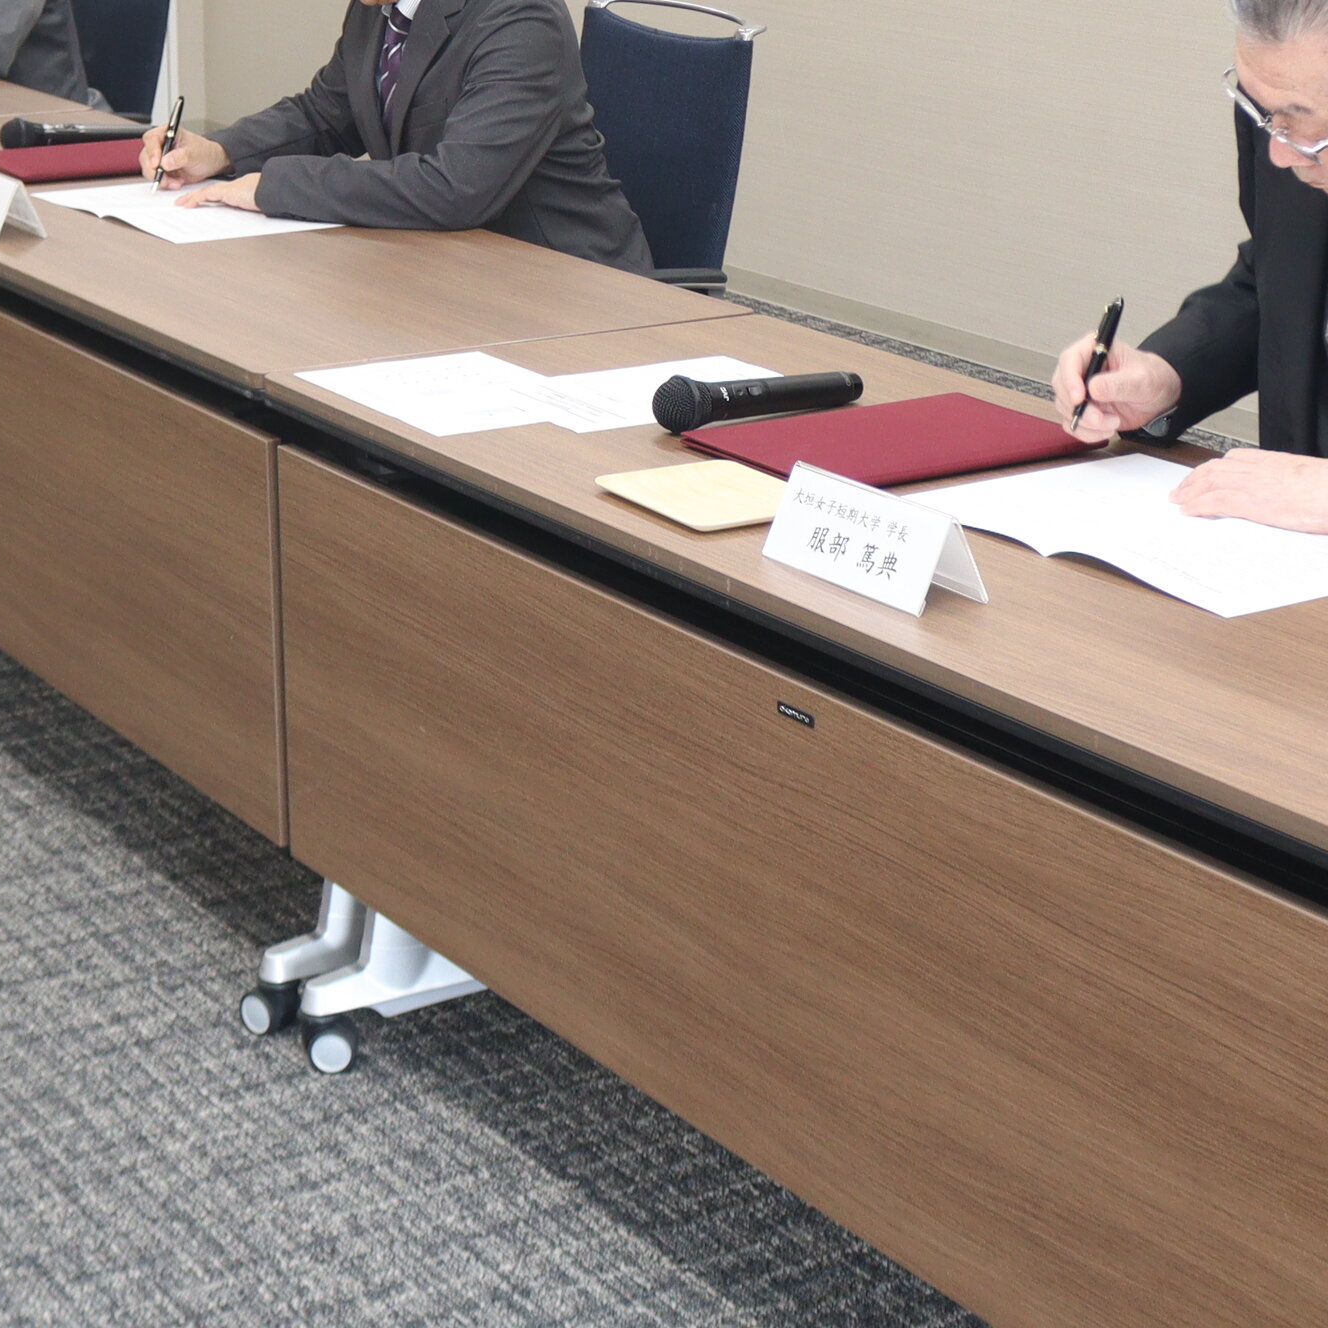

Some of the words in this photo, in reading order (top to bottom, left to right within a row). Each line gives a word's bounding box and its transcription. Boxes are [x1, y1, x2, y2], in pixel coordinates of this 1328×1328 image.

[793, 488, 881, 531] 大垣女子短期大学
[887, 521, 910, 543] 学長
[807, 526, 850, 561] 服部
[856, 543, 898, 580] 篤典
